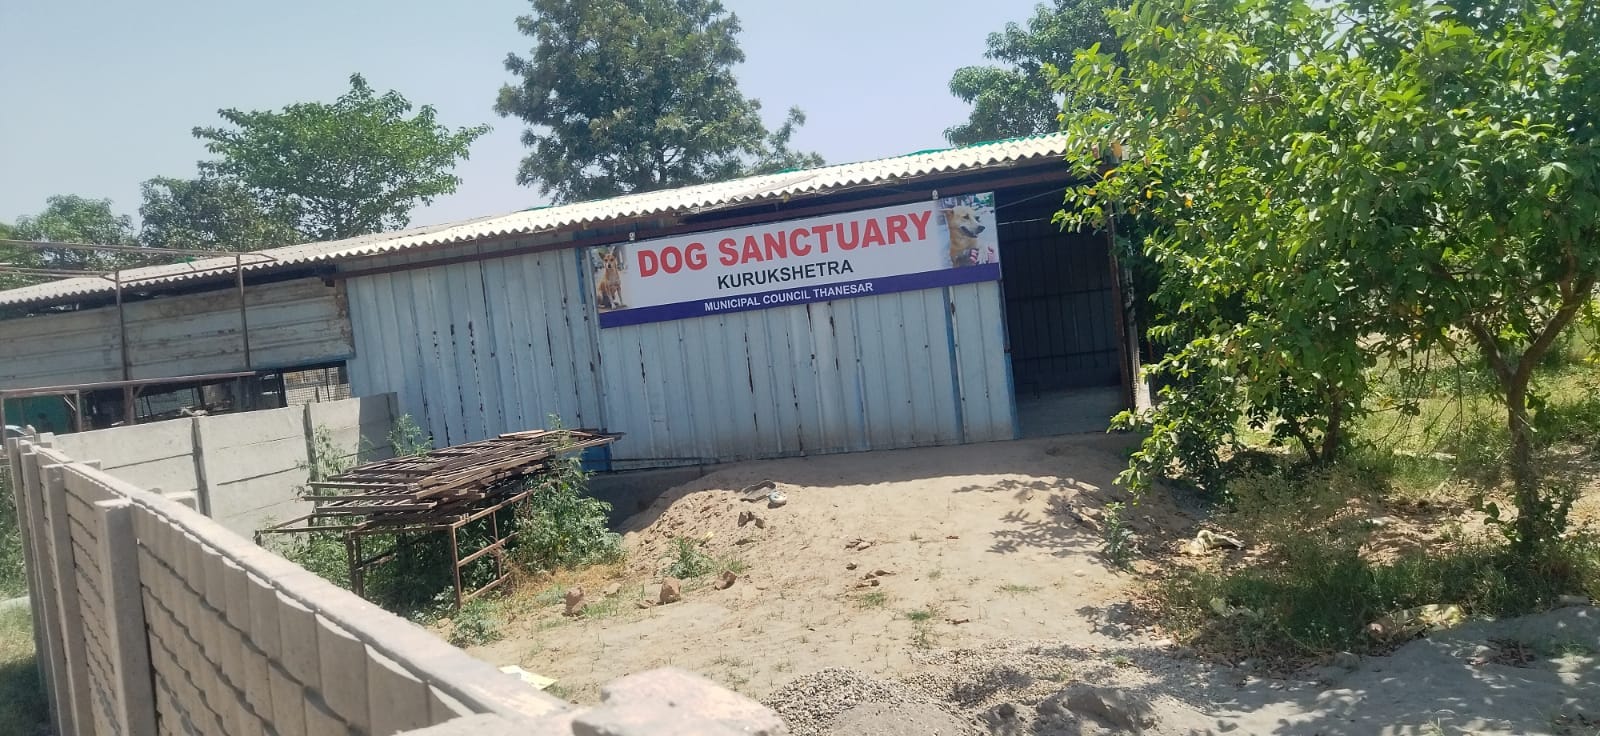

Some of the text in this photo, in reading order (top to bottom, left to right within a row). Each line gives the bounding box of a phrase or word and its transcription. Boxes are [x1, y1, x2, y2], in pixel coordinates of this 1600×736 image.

[638, 210, 932, 277] DOG SANCTUARY
[717, 259, 854, 290] KURUKSHETRA
[704, 282, 874, 312] MUNICIPAL COUNCIL THANESAR
